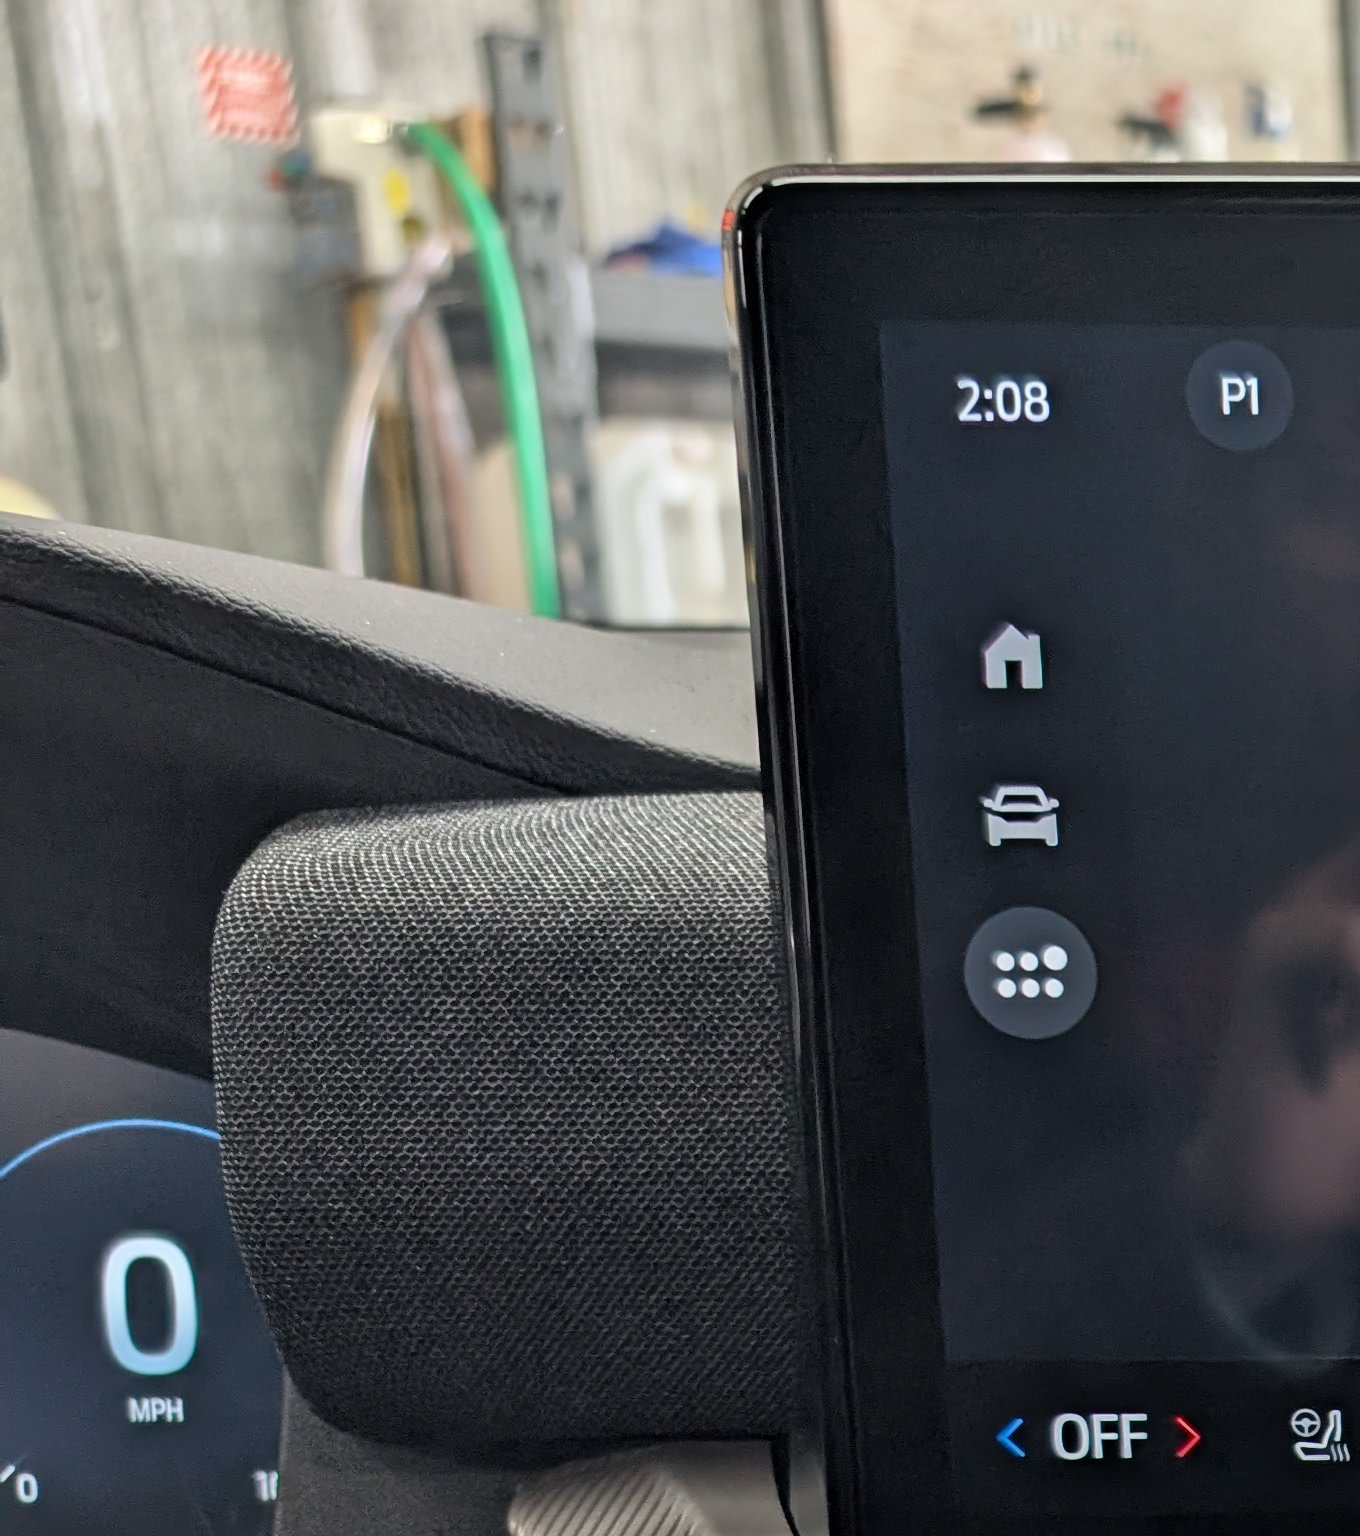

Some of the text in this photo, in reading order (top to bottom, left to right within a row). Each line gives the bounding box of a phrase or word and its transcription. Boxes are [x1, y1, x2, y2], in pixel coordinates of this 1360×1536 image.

[958, 377, 1052, 424] 2:08
[1222, 376, 1260, 417] P1
[102, 1236, 199, 1376] 0
[128, 1397, 184, 1423] MPH
[1051, 1413, 1149, 1462] OFF
[15, 1473, 39, 1504] 0
